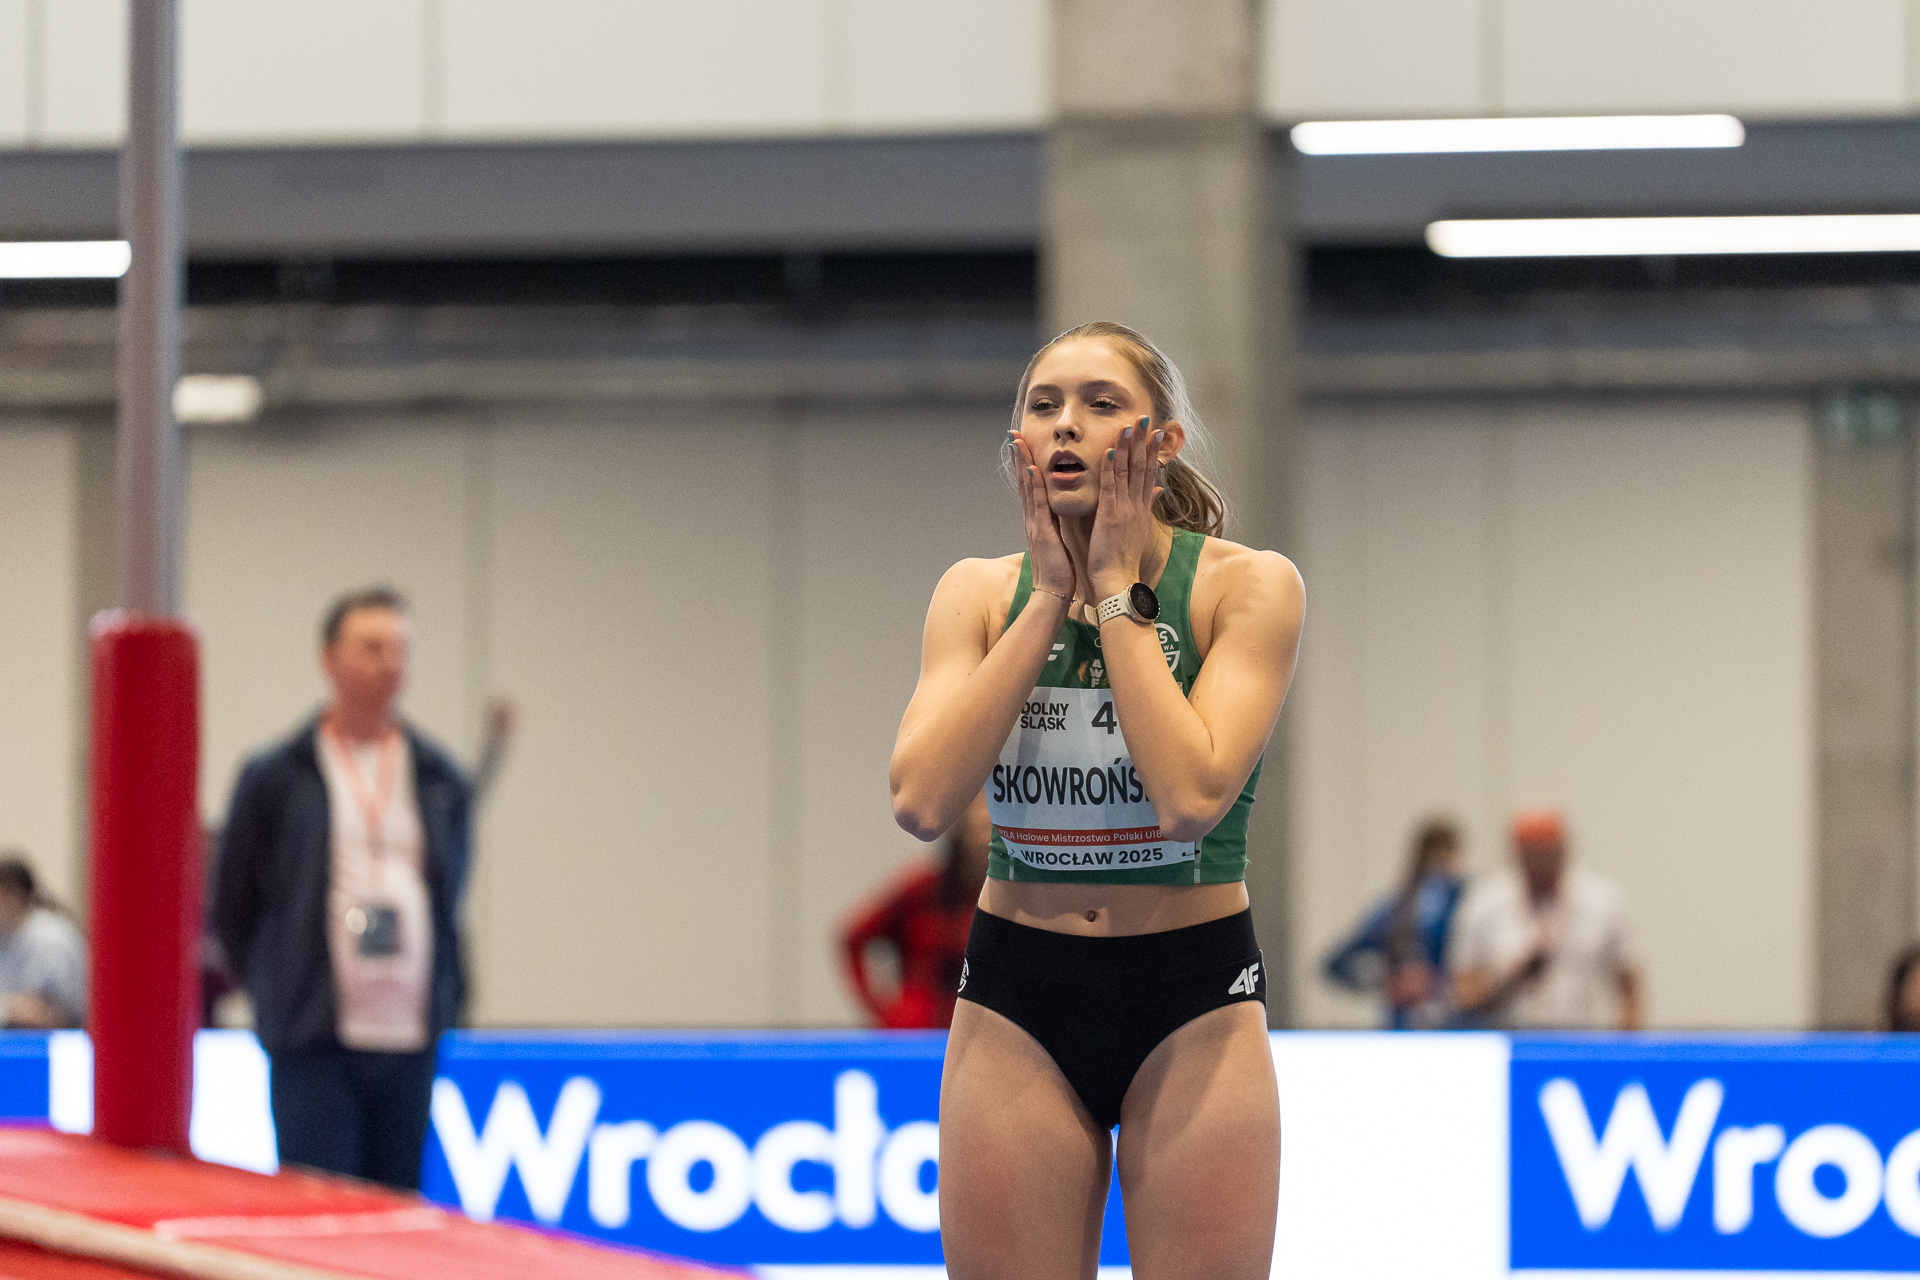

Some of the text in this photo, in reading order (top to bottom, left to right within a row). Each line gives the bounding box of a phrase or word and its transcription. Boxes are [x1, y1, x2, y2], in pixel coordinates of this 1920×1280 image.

[1021, 702, 1069, 716] DOLNY
[1020, 712, 1066, 732] ŚLĄSK
[992, 757, 1149, 805] SKOWROŃS
[1016, 832, 1050, 842] Halowe
[1051, 833, 1111, 843] Mistrzostwa
[1113, 831, 1143, 842] Polski
[1145, 829, 1162, 839] U18
[1020, 847, 1163, 866] WROCŁAW 2025
[1228, 962, 1259, 995] 4F
